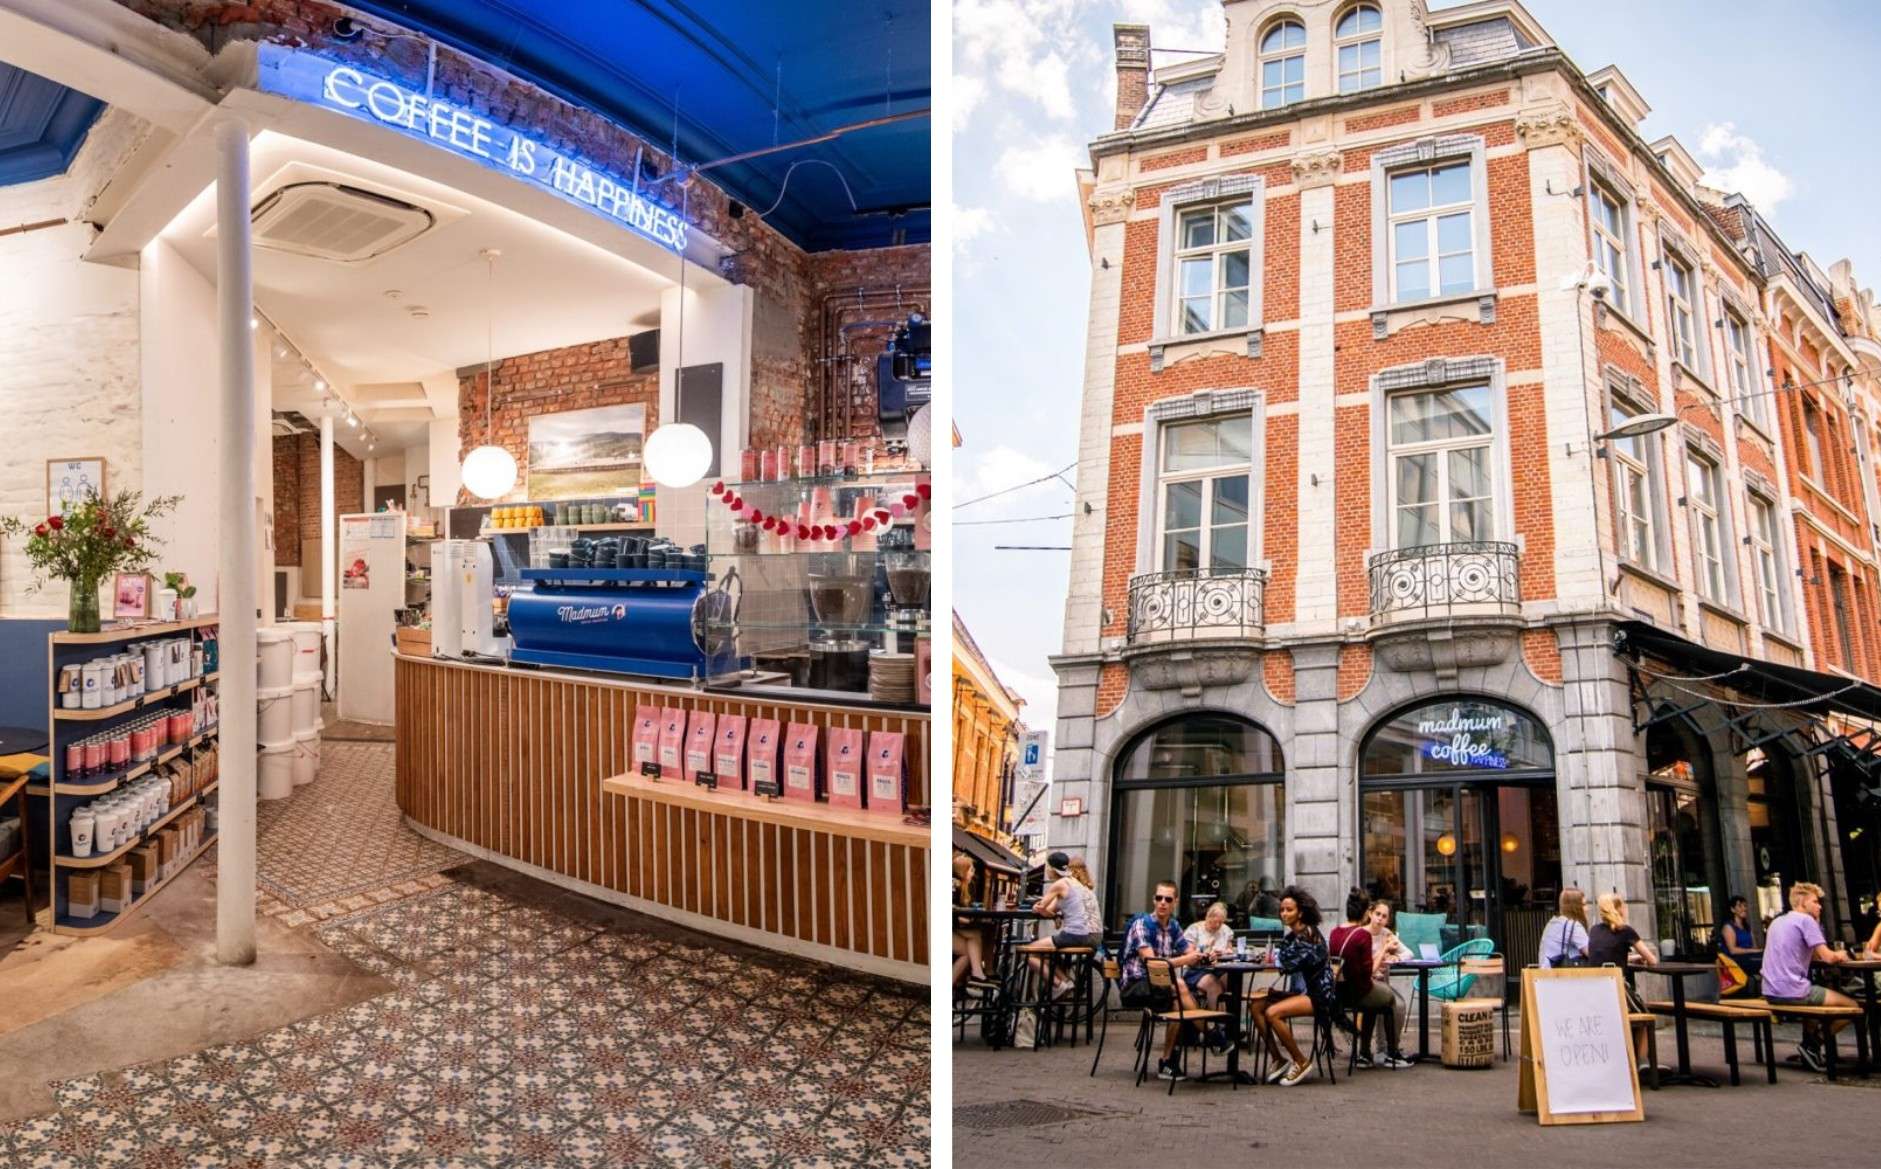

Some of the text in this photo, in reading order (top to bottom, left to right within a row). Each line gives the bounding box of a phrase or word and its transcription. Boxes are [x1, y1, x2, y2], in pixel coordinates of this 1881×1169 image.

[323, 66, 689, 250] COFFEE IS HAPPINESS
[557, 605, 610, 623] Madmum
[1418, 708, 1502, 733] madmum
[1431, 733, 1491, 765] coffee
[1458, 1011, 1488, 1023] CLEAN
[1554, 1015, 1603, 1038] WE ARE
